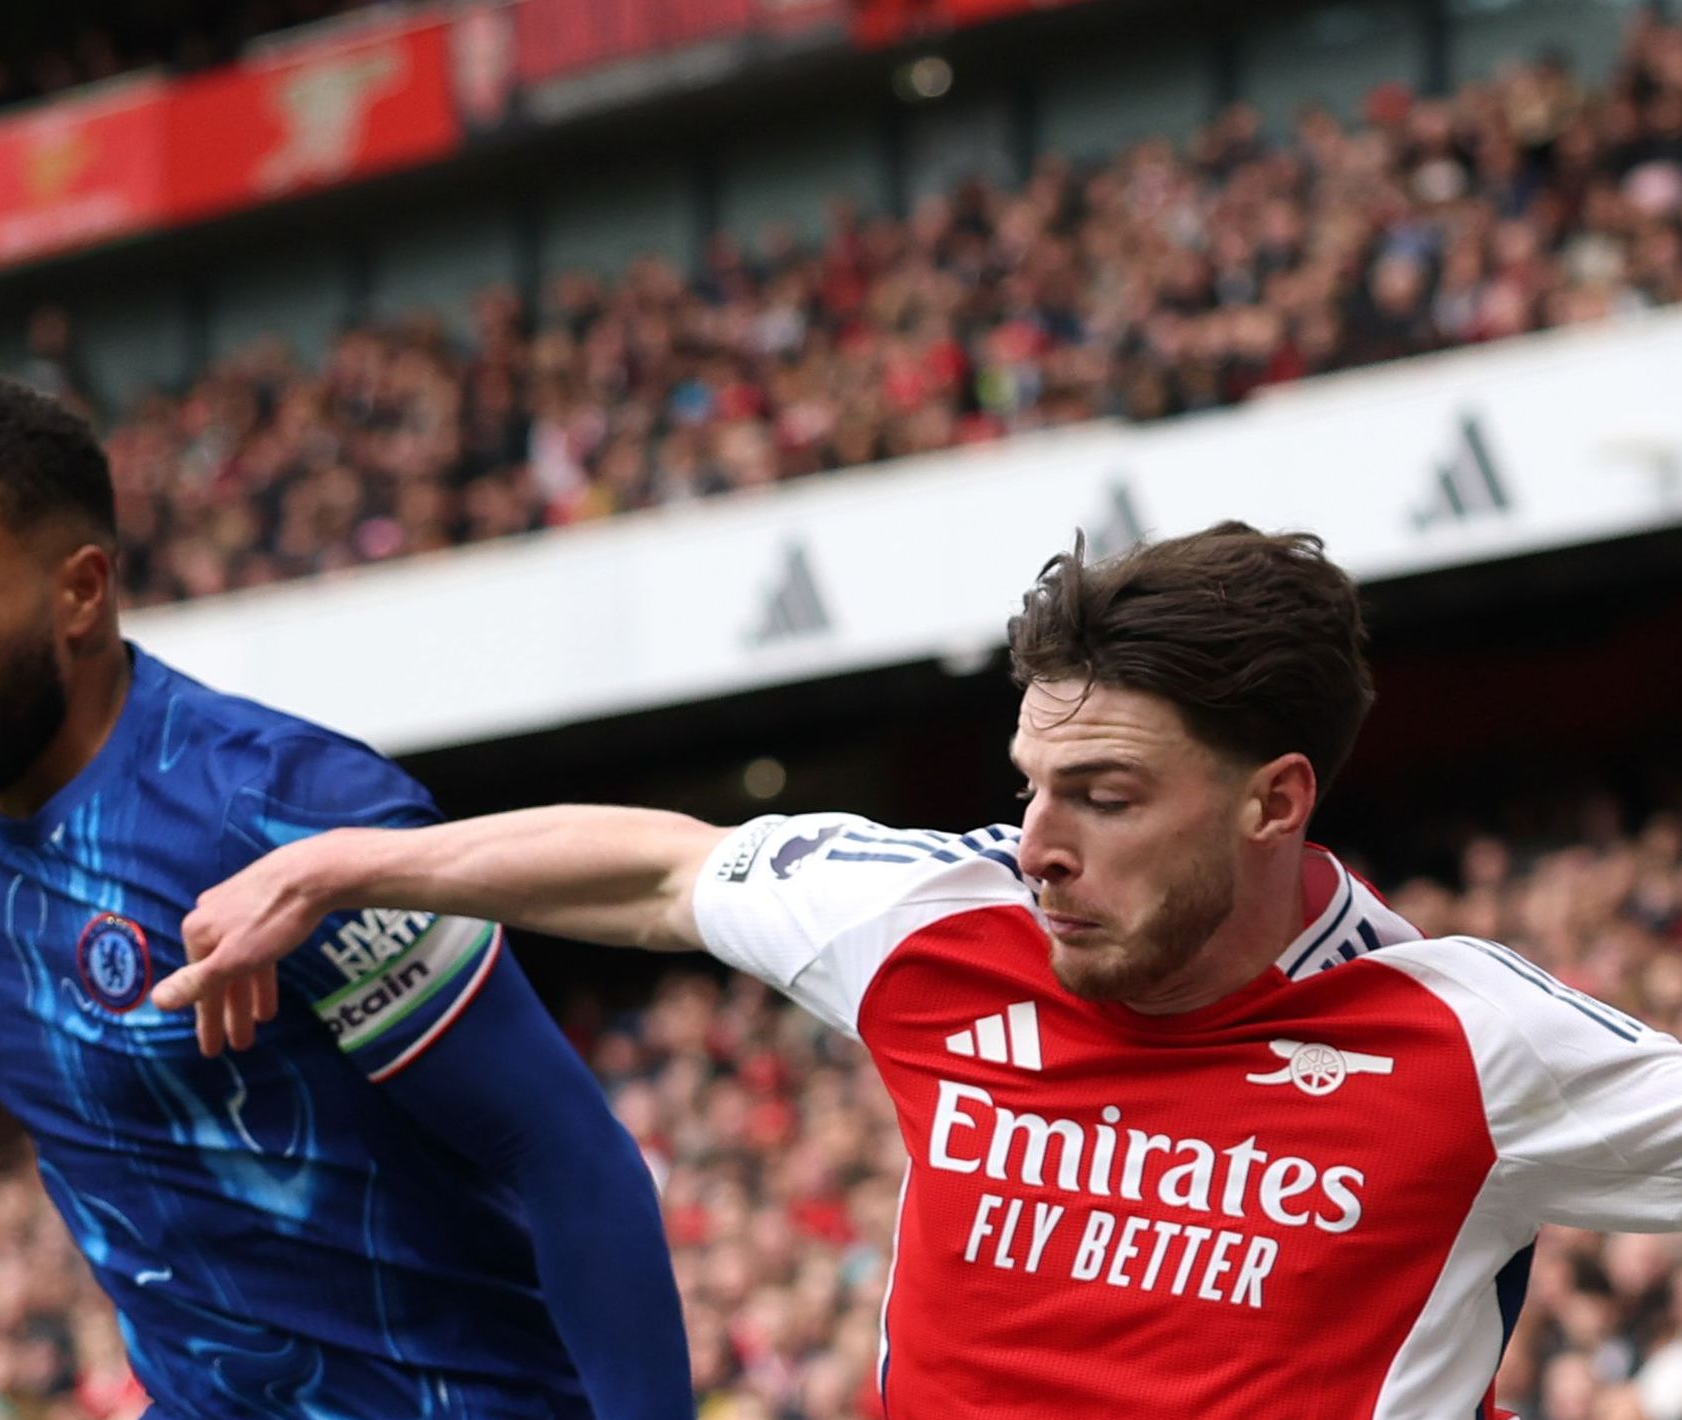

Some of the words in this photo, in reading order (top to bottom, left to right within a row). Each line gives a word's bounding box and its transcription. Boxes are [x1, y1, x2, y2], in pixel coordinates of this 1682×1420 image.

[929, 1080, 1364, 1234] Emirates
[965, 1193, 1064, 1273] FLY
[1071, 1210, 1279, 1308] BETTER
